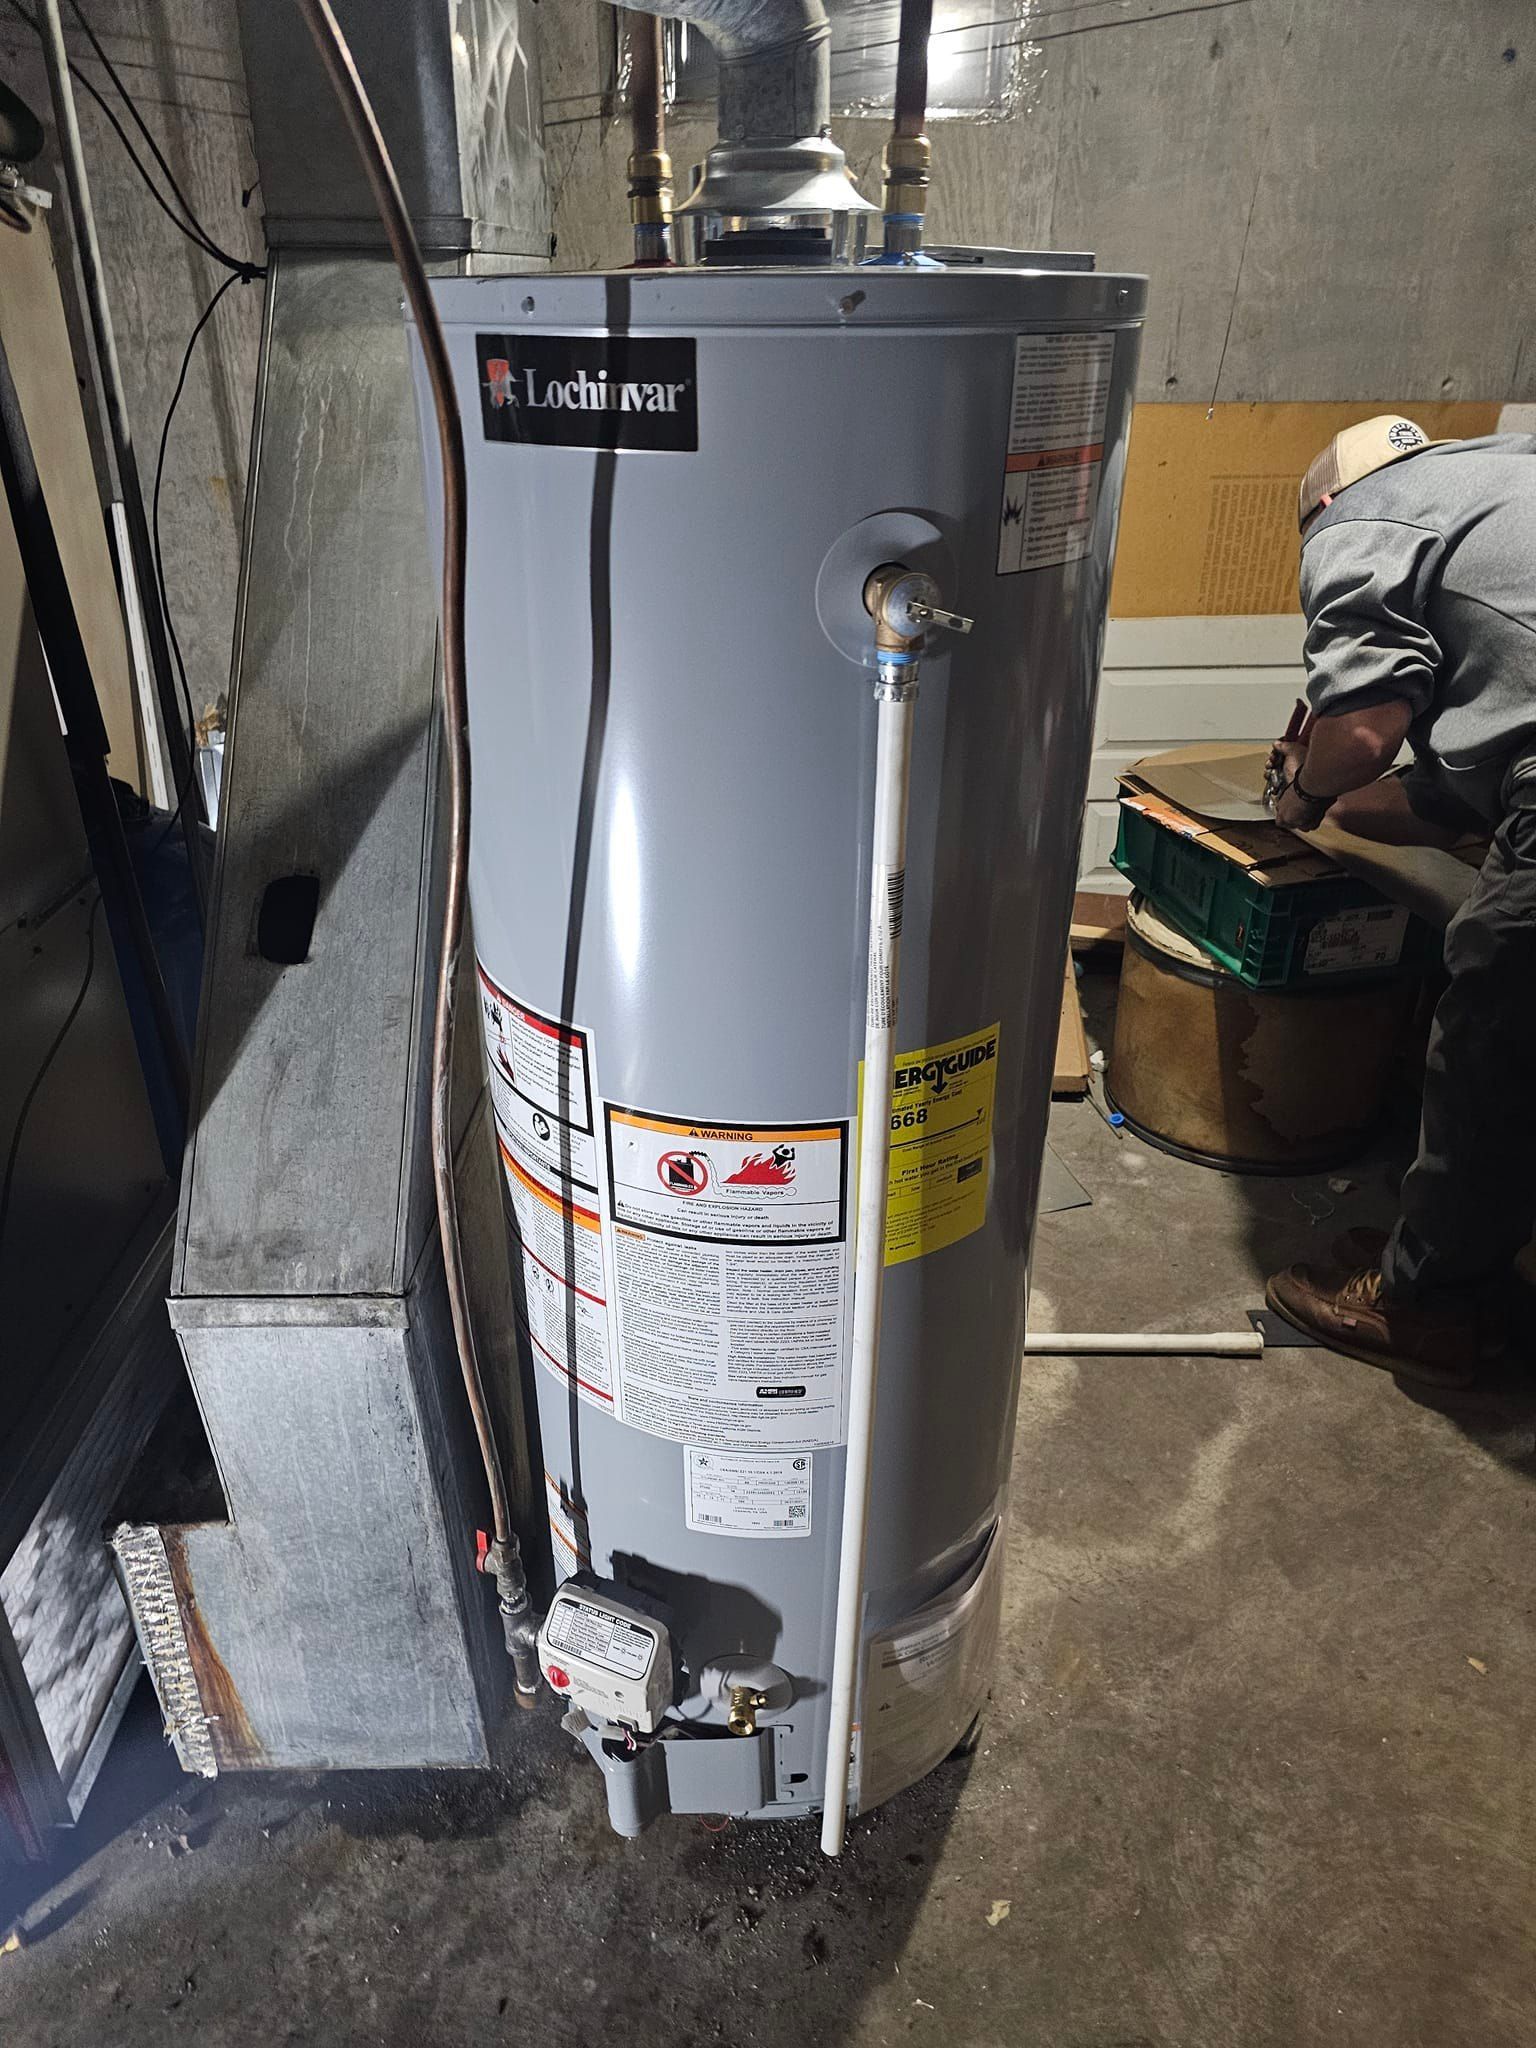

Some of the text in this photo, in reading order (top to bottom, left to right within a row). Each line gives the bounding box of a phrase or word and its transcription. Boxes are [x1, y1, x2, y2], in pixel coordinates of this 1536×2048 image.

[523, 369, 686, 412] Lochinvar
[700, 1130, 753, 1141] WARNING
[902, 1154, 959, 1176] First Hour Rating
[579, 1604, 632, 1629] STATUS LIGHT CODE
